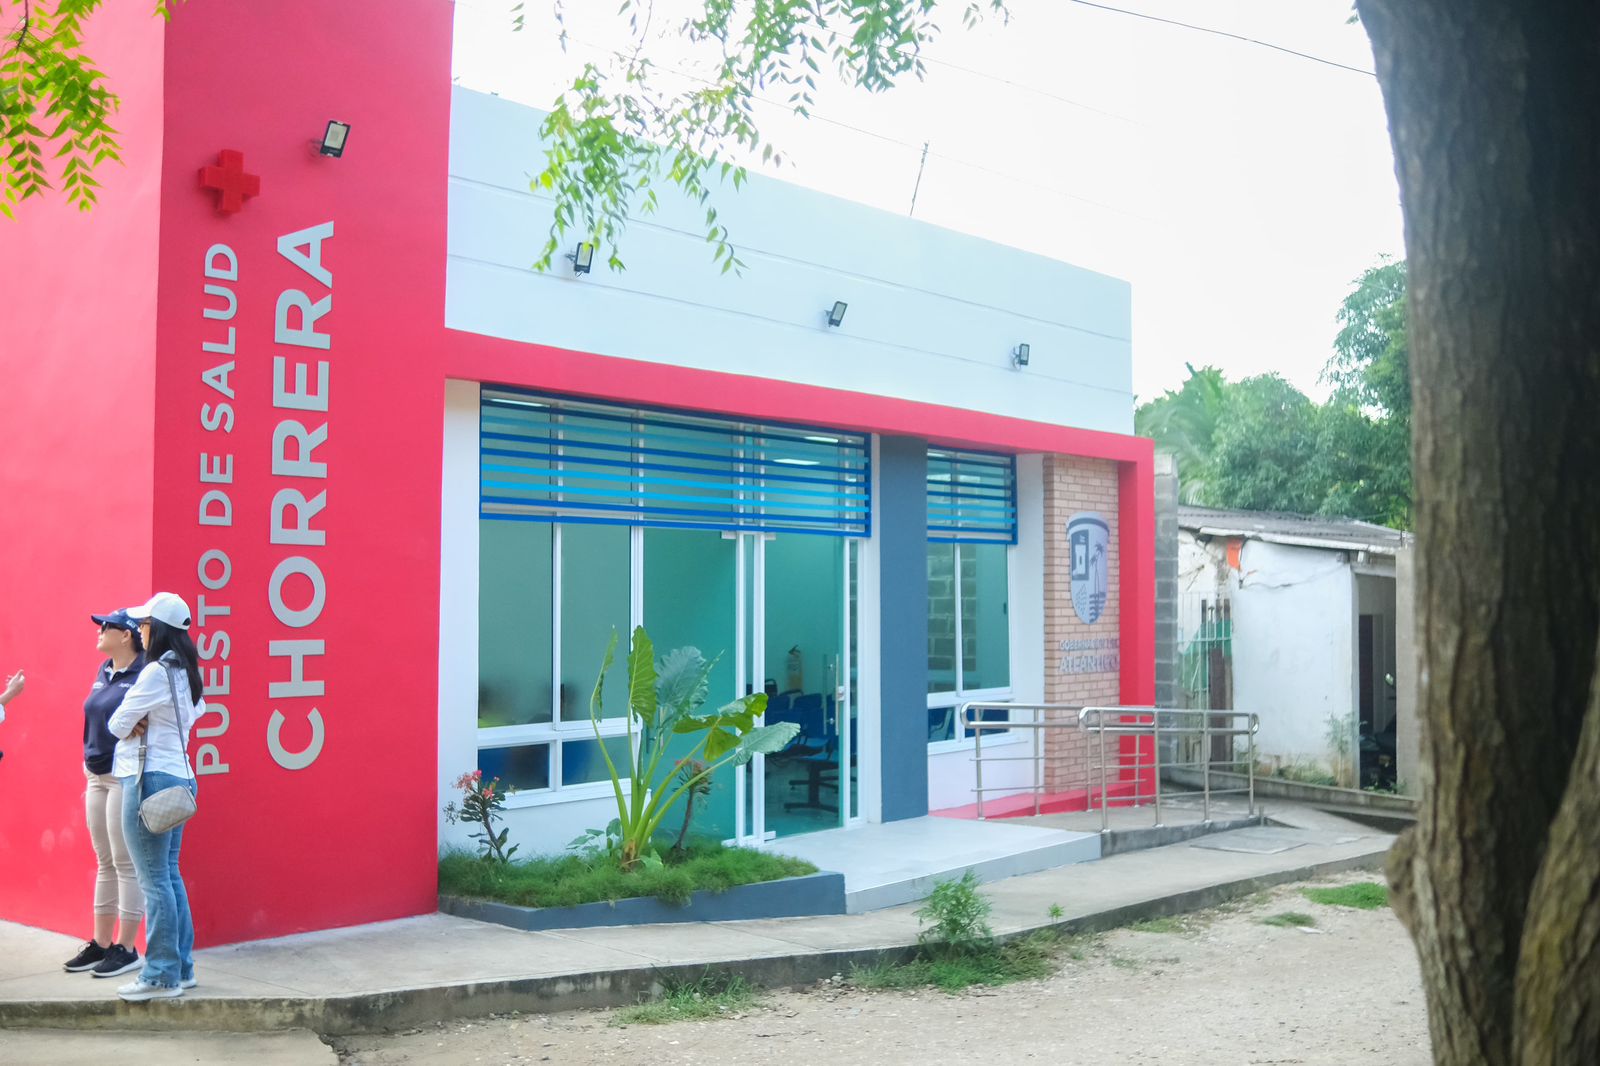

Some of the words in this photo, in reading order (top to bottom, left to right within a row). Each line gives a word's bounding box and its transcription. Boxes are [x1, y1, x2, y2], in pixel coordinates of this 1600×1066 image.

[201, 243, 238, 433] SALUD
[199, 453, 233, 526] DE
[267, 220, 335, 770] CHORRERA
[196, 549, 232, 775] PUESTO
